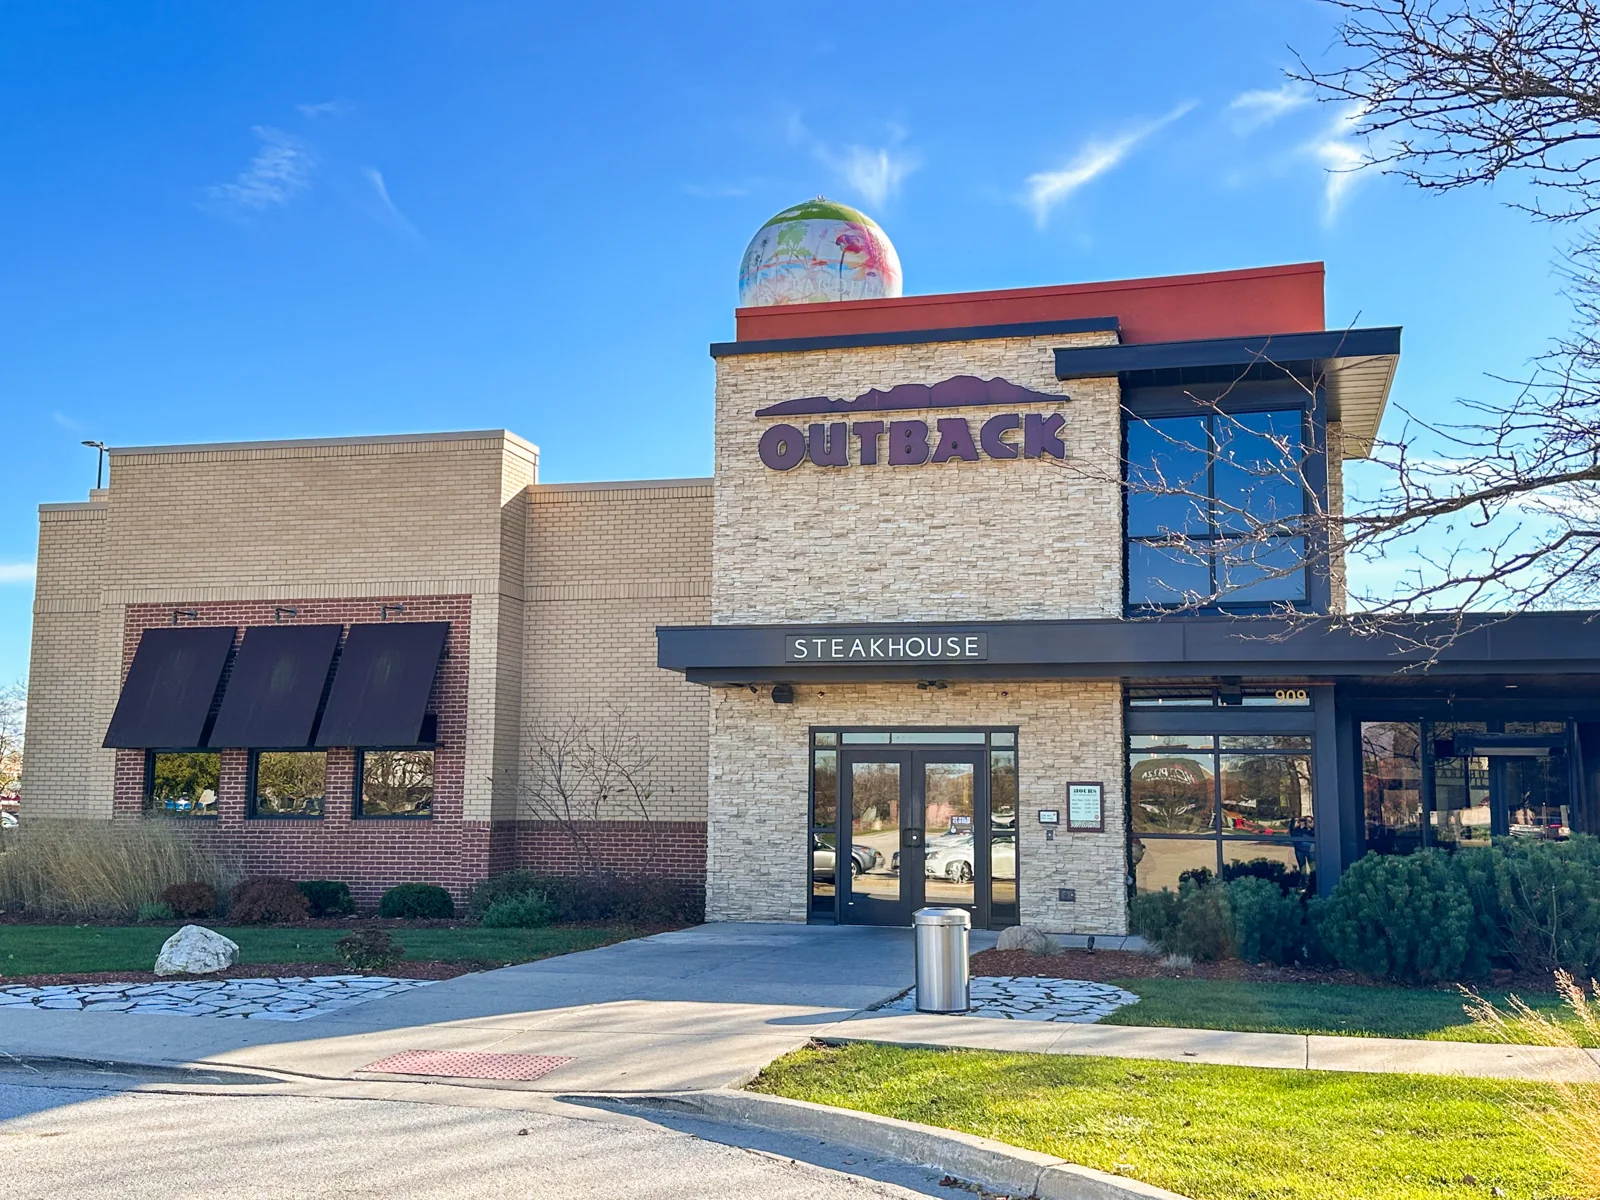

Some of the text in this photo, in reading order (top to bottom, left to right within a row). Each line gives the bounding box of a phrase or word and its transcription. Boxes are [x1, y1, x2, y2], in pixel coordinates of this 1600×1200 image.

[758, 413, 1066, 471] OUTBACK
[794, 637, 979, 658] STEAKHOUSE
[1275, 689, 1307, 704] 909
